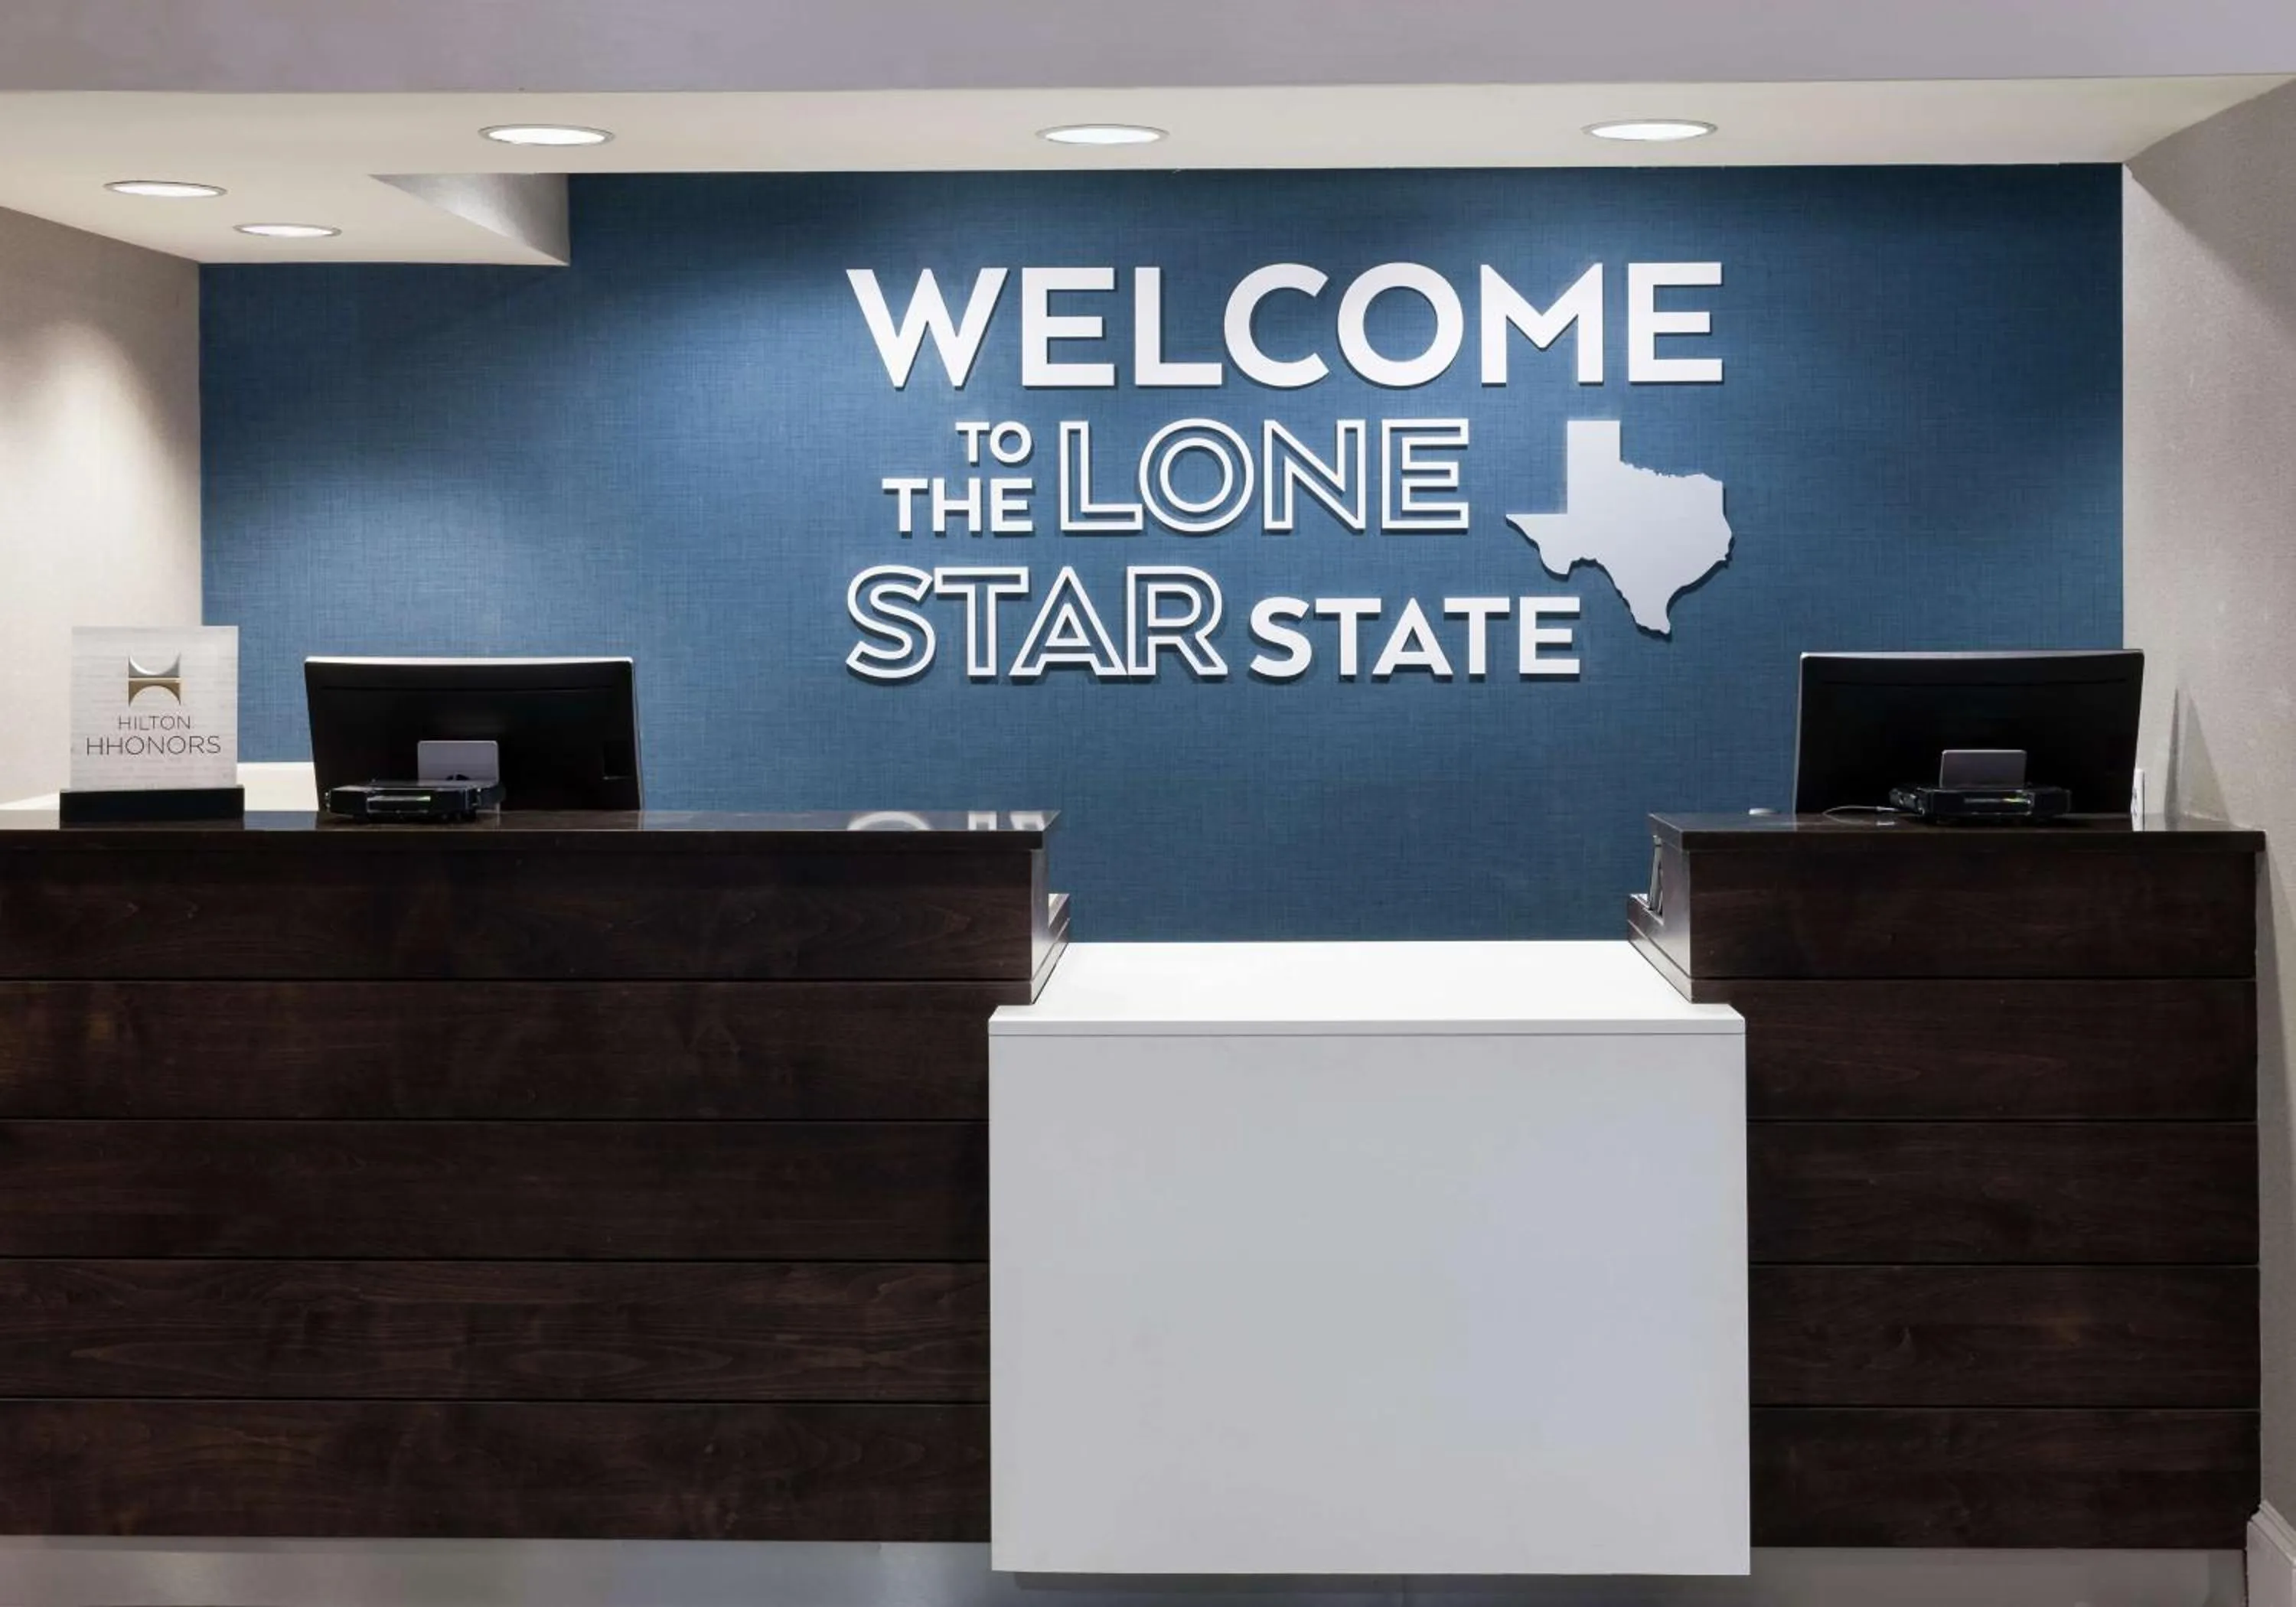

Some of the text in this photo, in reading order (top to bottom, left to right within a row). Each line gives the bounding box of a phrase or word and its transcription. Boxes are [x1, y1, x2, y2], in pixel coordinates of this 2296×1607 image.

[846, 262, 1724, 388] WELCOME
[882, 418, 1469, 533] THE LONE
[954, 420, 1033, 464] TO
[846, 564, 1581, 679] STAR STATE
[86, 735, 222, 756] HHONORS
[117, 715, 191, 731] HILTON
